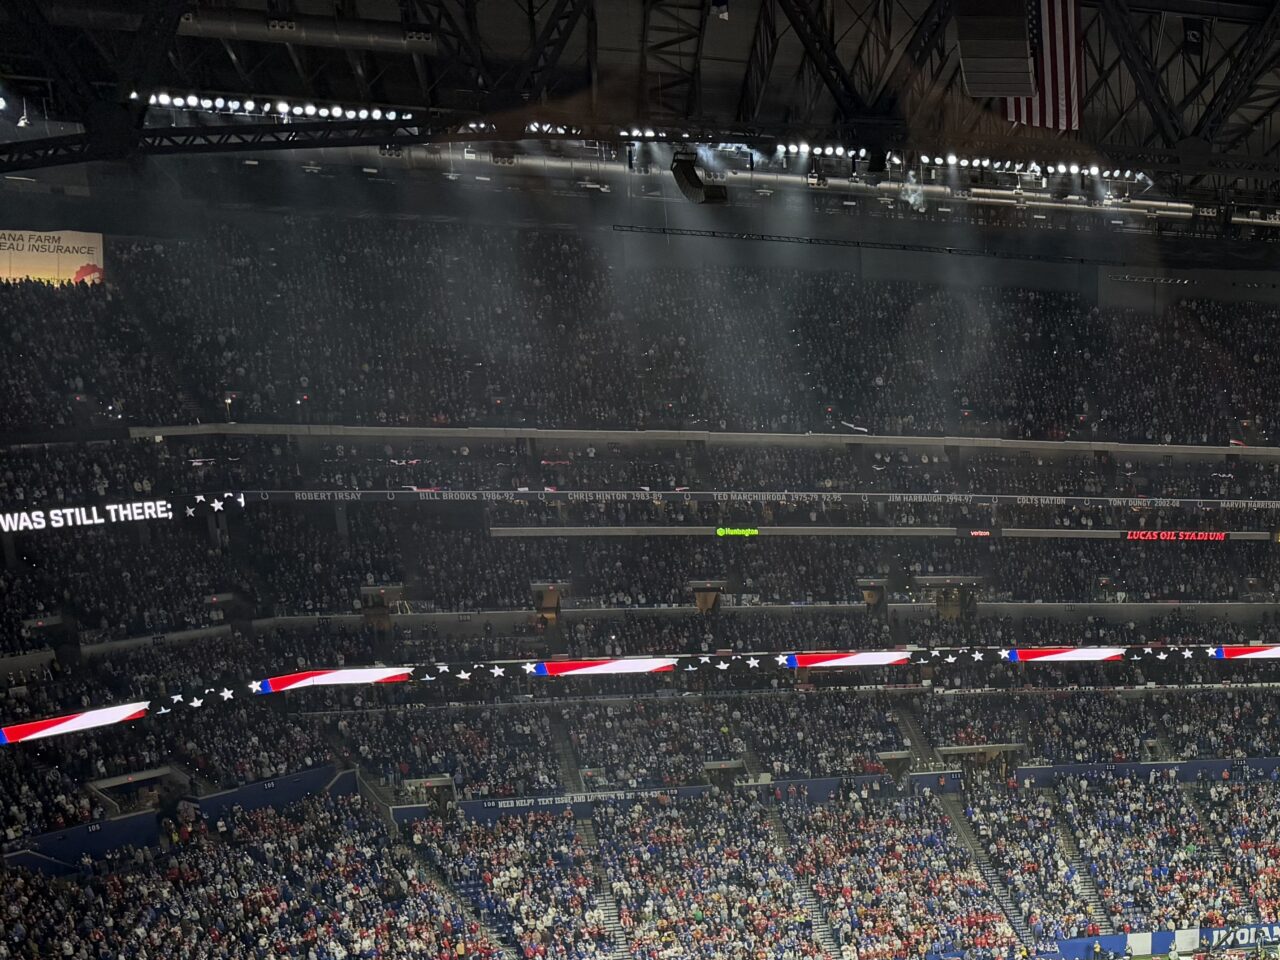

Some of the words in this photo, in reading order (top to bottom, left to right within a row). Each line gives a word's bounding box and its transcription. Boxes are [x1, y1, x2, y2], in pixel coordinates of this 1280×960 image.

[28, 234, 61, 244] FARM
[28, 244, 95, 255] INSURANCE
[295, 492, 333, 501] ROBERT
[335, 492, 362, 501] IRSAY
[420, 491, 440, 501] BILL
[443, 492, 477, 501] BROOKS
[568, 492, 594, 501] CHRIS
[596, 492, 627, 501] HINTON
[0, 510, 46, 533] WAS
[49, 506, 105, 528] STILL
[105, 499, 173, 523] THERE;
[1127, 531, 1158, 540] LUCAS
[1160, 531, 1177, 540] OIL
[1179, 532, 1226, 541] STADIUM
